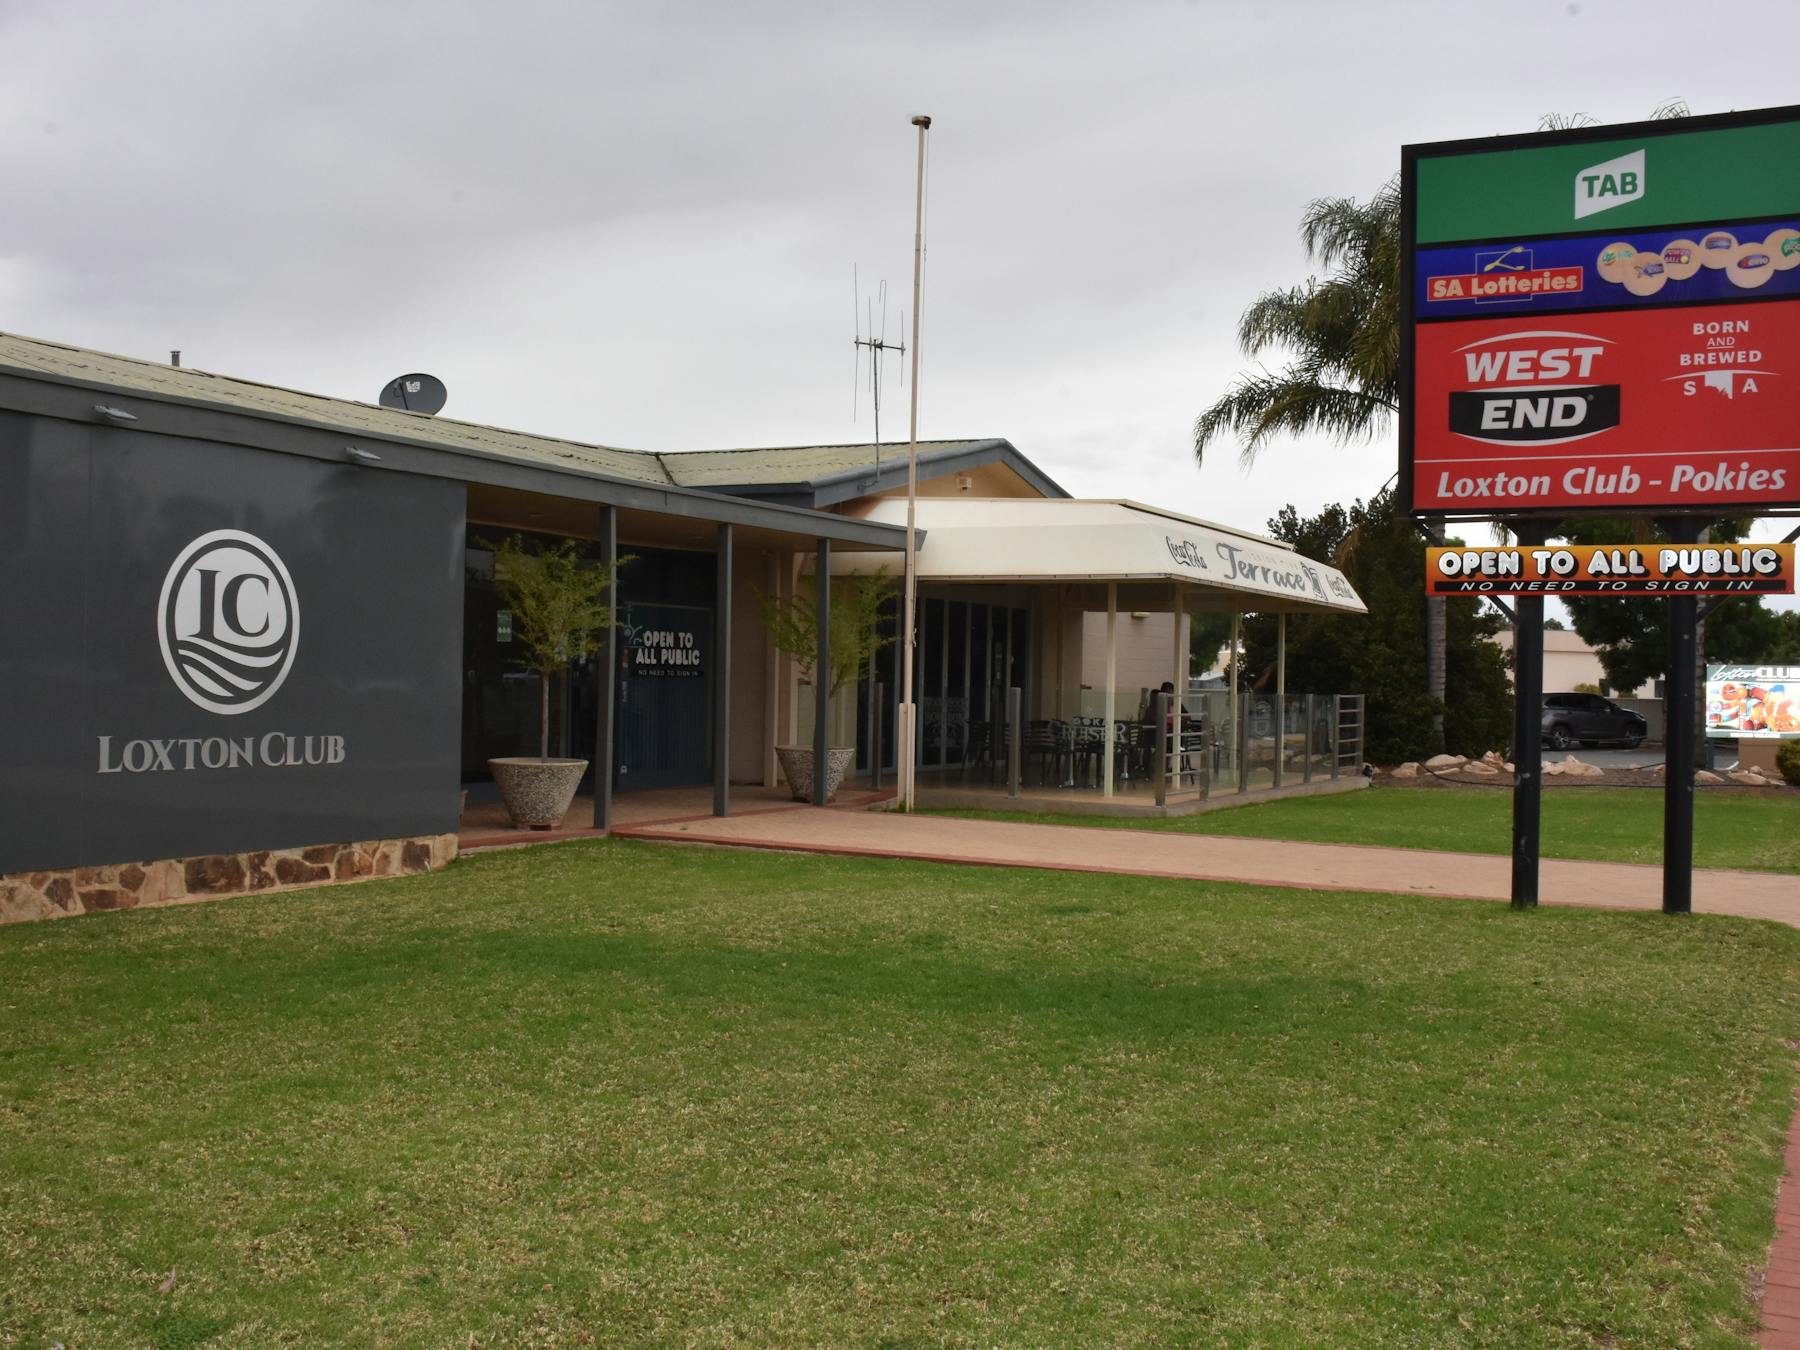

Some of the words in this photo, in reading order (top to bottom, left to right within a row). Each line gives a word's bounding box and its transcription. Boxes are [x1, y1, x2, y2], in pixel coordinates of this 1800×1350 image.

[1582, 172, 1638, 198] TAB
[1433, 277, 1462, 298] SA
[1471, 272, 1578, 297] Lotteries
[1693, 320, 1749, 335] BORN
[1707, 336, 1735, 347] AND
[1464, 346, 1604, 382] WEST
[1680, 350, 1762, 366] BREWED
[1683, 380, 1696, 396] S
[1742, 378, 1758, 393] A
[1480, 396, 1588, 430] END
[1437, 471, 1550, 498] Loxton
[1562, 465, 1641, 494] Club
[1670, 462, 1787, 492] Pokies
[1216, 542, 1306, 592] Terrace
[1438, 551, 1521, 576] OPEN
[1532, 550, 1577, 575] TO
[1587, 550, 1647, 575] ALL
[1660, 548, 1779, 575] PUBLIC
[1460, 582, 1495, 591] NO
[1509, 581, 1576, 591] NEED
[1598, 581, 1626, 591] TO
[1645, 580, 1710, 591] SIGN
[1727, 580, 1754, 590] IN
[643, 631, 674, 648] OPEN
[678, 632, 693, 648] TO
[636, 648, 657, 665] ALL
[660, 649, 700, 666] PUBLIC
[1758, 666, 1800, 680] CLUB
[96, 735, 255, 773] LOXTON
[259, 731, 346, 767] CLUB
